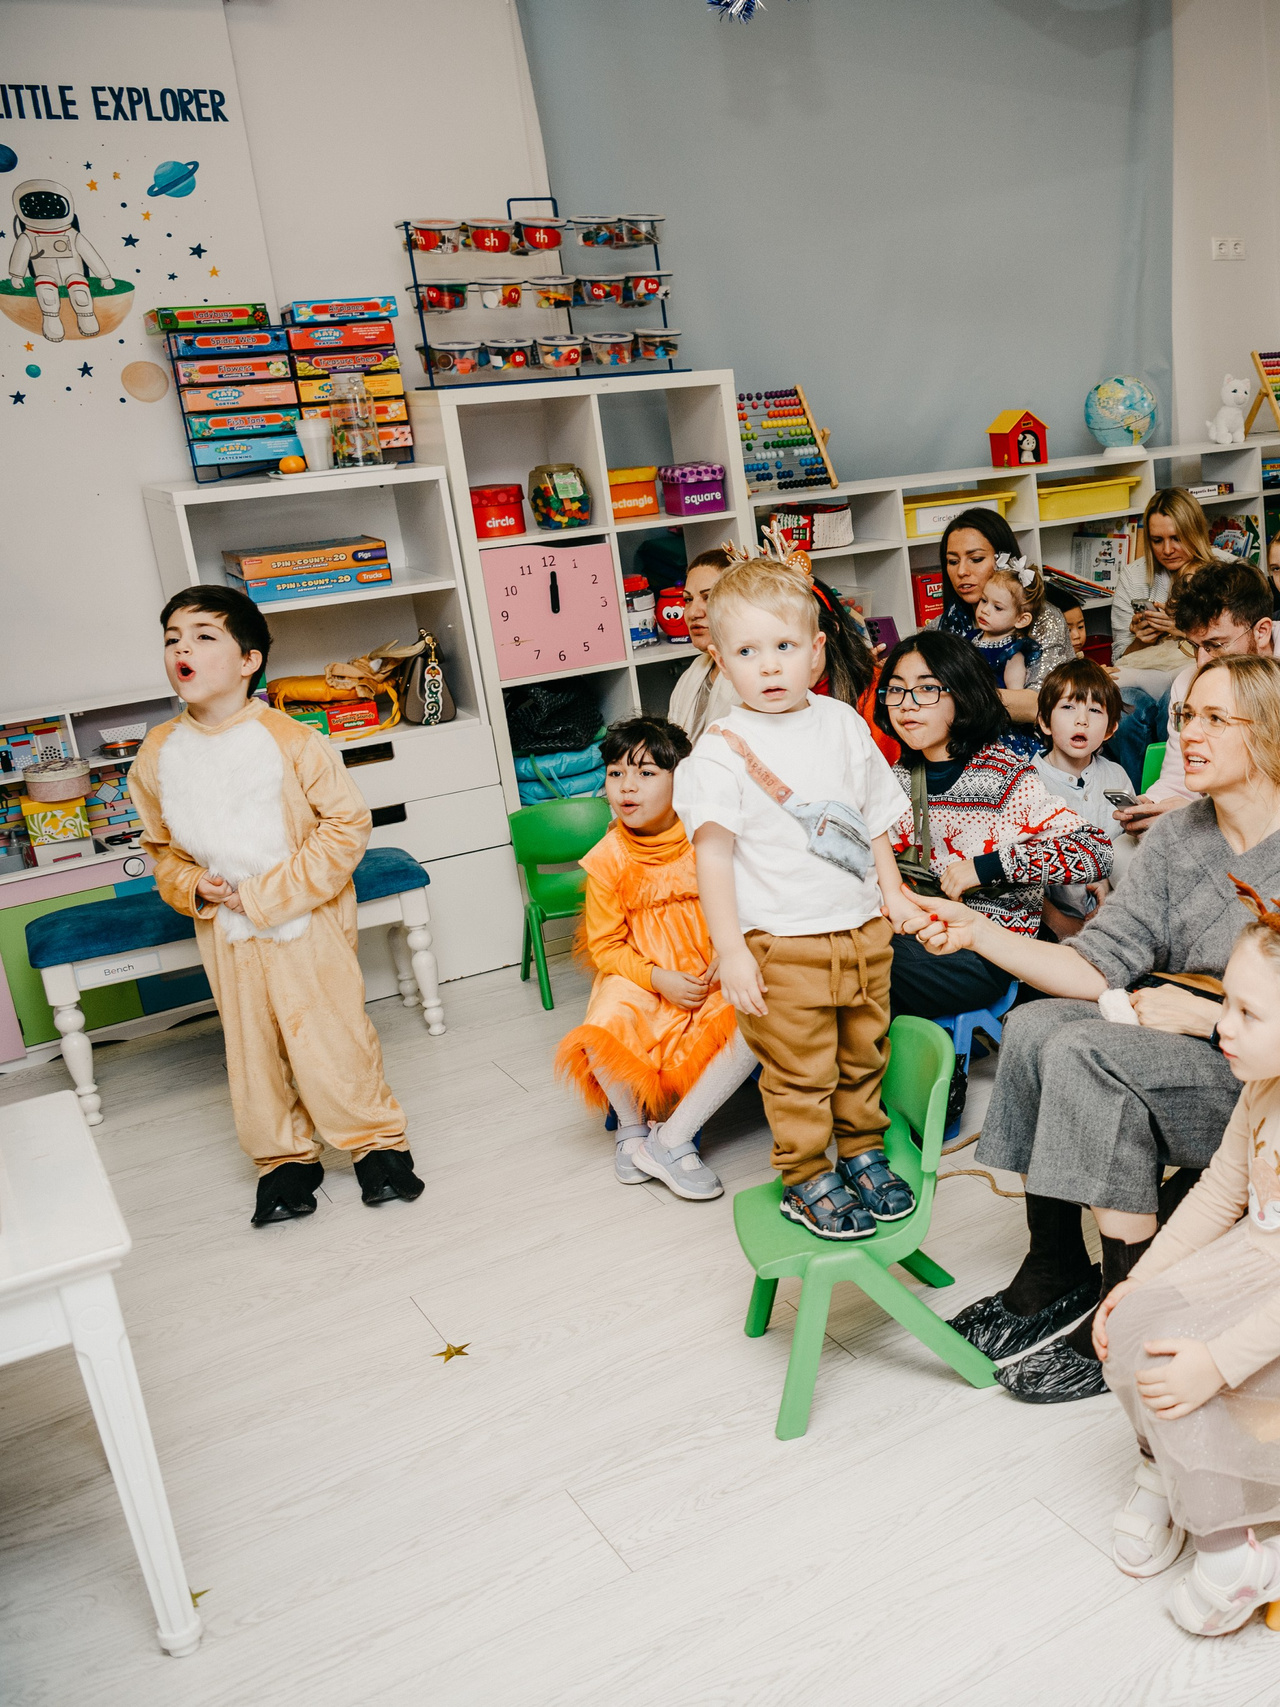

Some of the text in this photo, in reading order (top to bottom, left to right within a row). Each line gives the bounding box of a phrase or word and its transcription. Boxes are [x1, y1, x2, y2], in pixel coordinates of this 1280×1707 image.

[0, 84, 229, 122] ITTLE EXPLORER
[484, 233, 499, 247] sh
[535, 229, 548, 243] th
[511, 291, 519, 300] Yy
[328, 304, 364, 313] Airplanes
[193, 310, 233, 319] Ladybugs
[210, 337, 237, 346] Spider
[319, 354, 377, 366] Treasure Chest
[218, 365, 252, 373] Flowers
[212, 388, 239, 398] MATH
[220, 445, 248, 453] MATH
[612, 495, 654, 509] ectangle
[684, 490, 722, 506] square
[486, 516, 515, 528] circle
[932, 514, 953, 523] Circle
[271, 560, 291, 569] SPIN
[296, 556, 325, 565] COUNT
[333, 553, 347, 562] 20
[357, 551, 372, 560] Pigs
[541, 555, 557, 568] 12
[572, 559, 578, 569] 1
[362, 571, 383, 580] Trucks
[519, 565, 533, 576] 11
[276, 582, 296, 591] SPIN
[301, 578, 330, 587] COUNT
[338, 574, 352, 583] 20
[591, 574, 599, 585] 2
[504, 586, 518, 598] 10
[600, 596, 608, 607] 3
[501, 611, 509, 622] 9
[597, 623, 605, 633] 4
[513, 636, 521, 647] 8
[582, 642, 590, 652] 5
[534, 650, 541, 660] 7
[558, 651, 567, 662] 6
[103, 964, 135, 976] Bench
